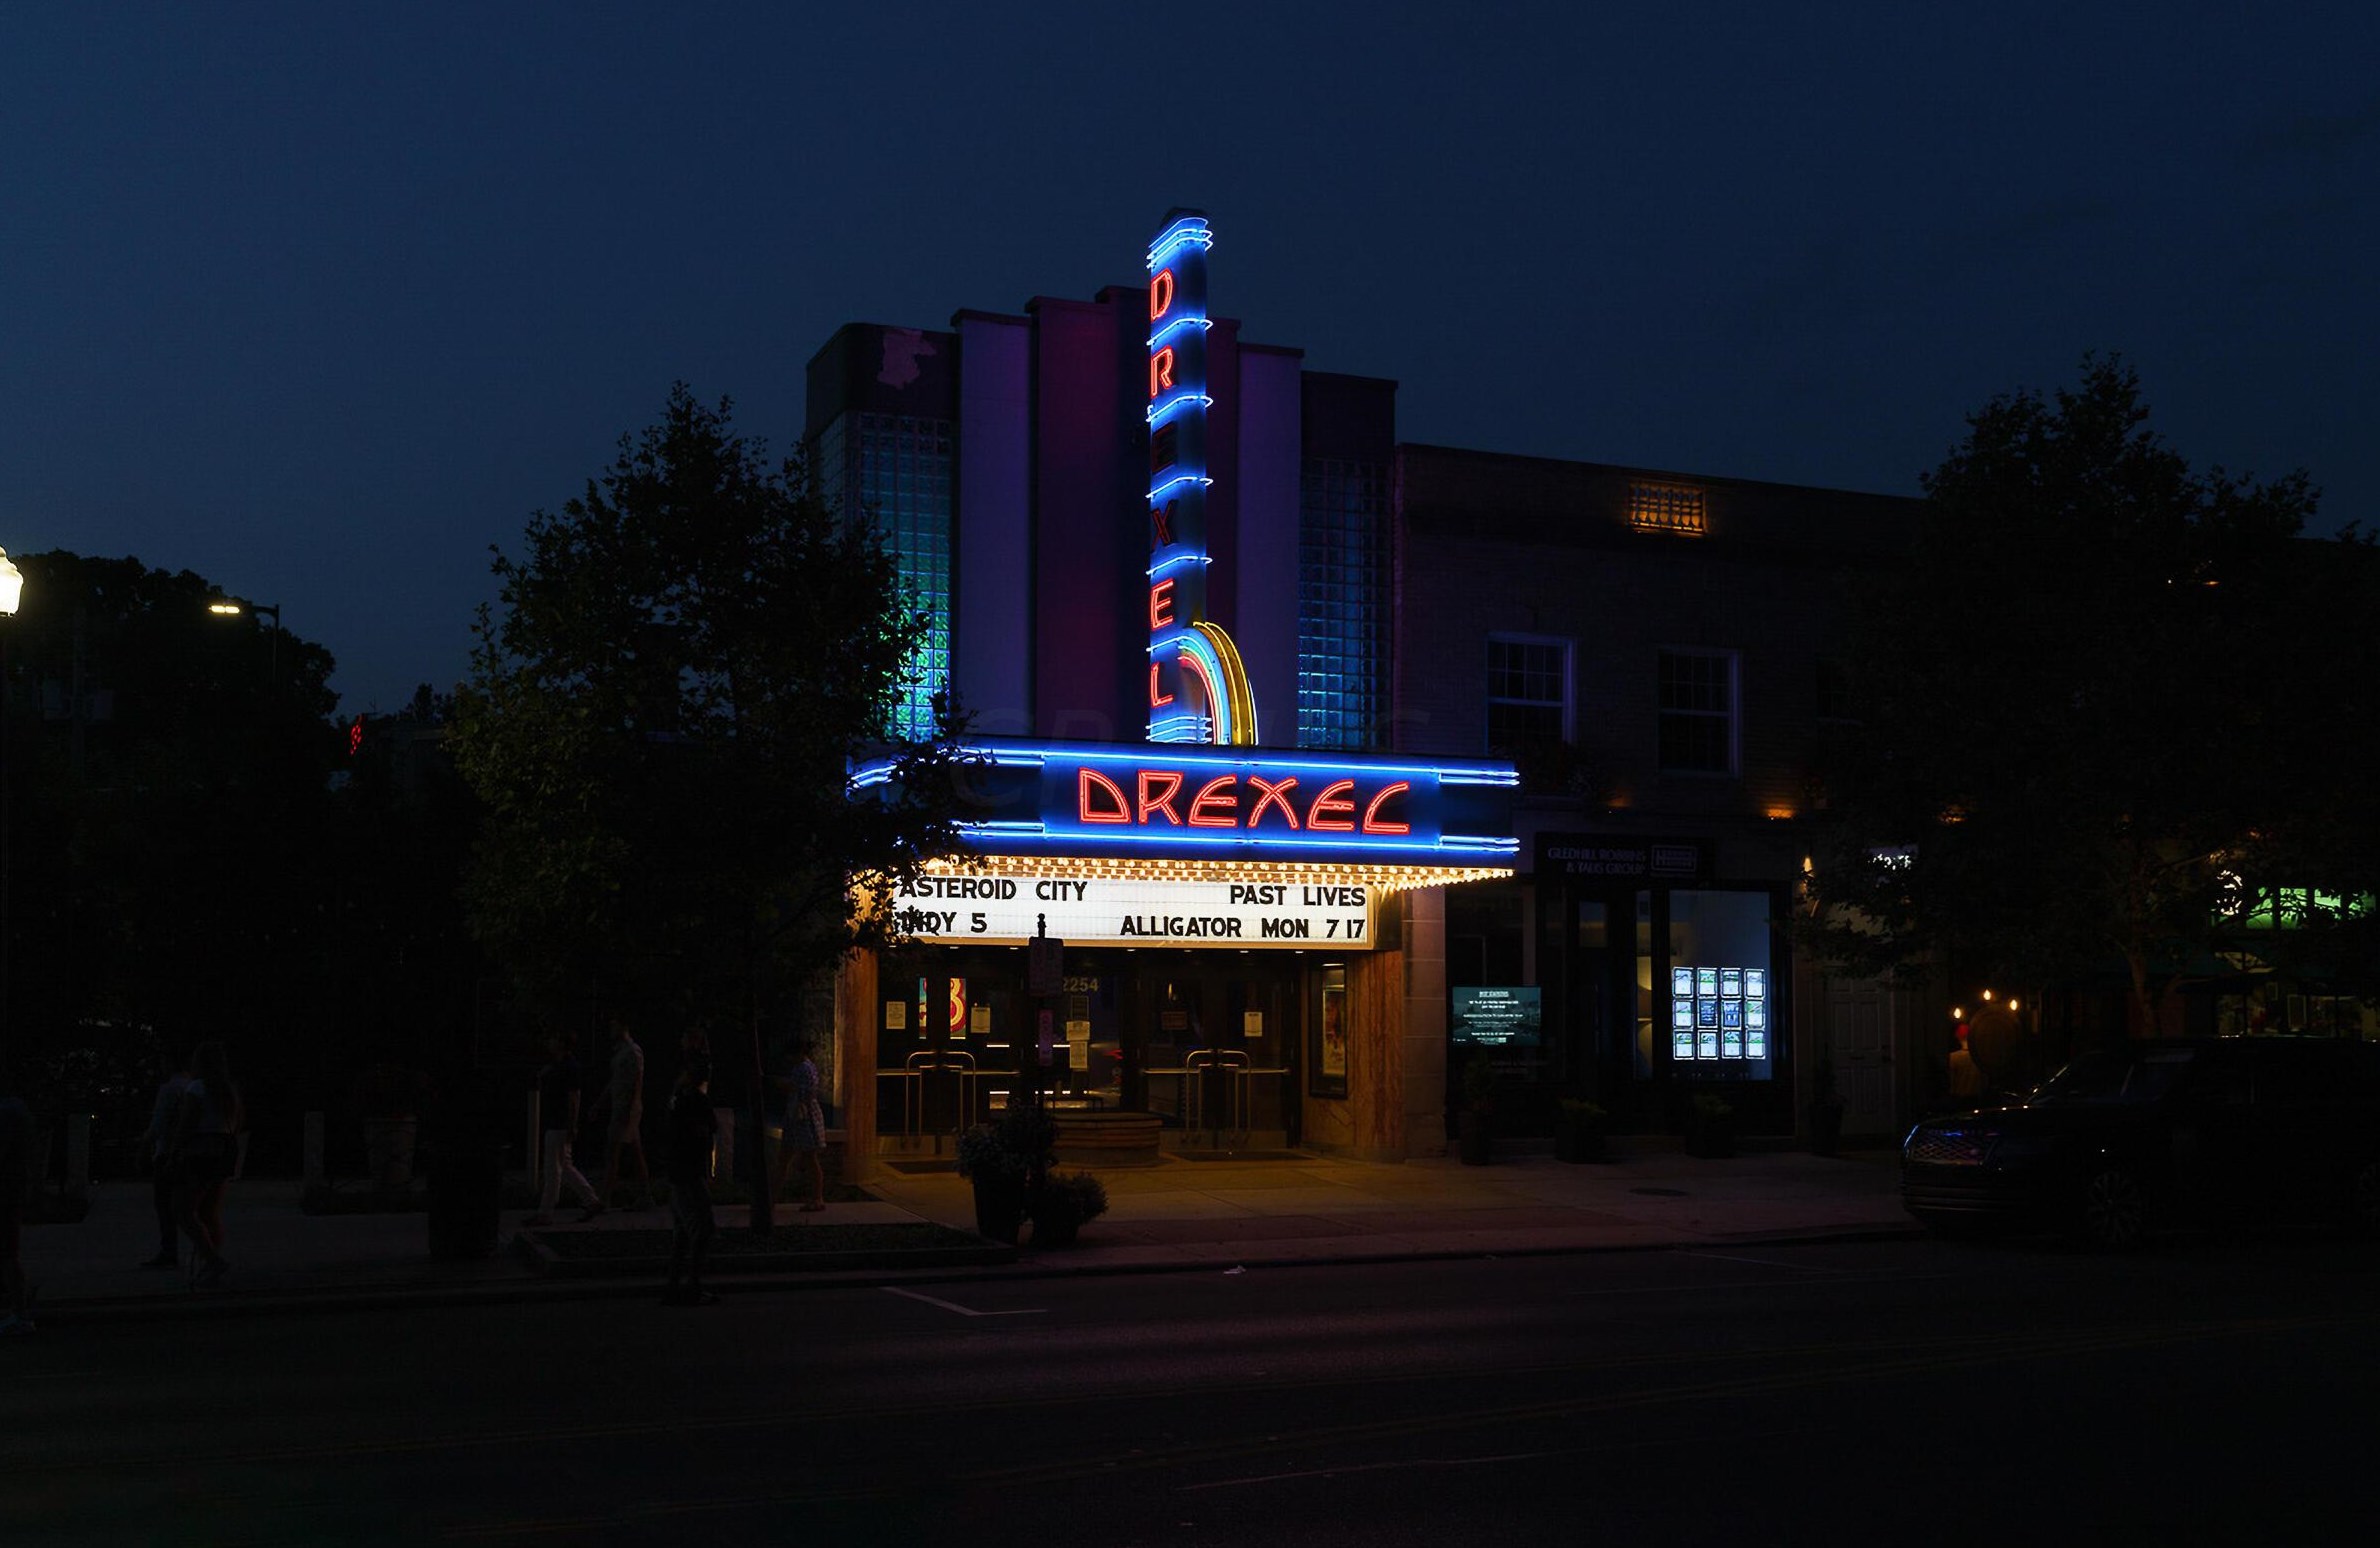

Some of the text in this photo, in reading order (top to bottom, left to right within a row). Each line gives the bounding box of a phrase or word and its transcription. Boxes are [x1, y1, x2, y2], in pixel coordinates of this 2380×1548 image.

[1149, 268, 1177, 708] DREXEL
[1079, 767, 1409, 834] DREXEL
[899, 877, 1088, 901] ASTEROID CITY
[1230, 885, 1365, 906] PAST LIVES
[971, 912, 988, 933] 5
[1120, 915, 1365, 938] ALLIGATOR MON 7 17
[1062, 976, 1100, 992] 2254
